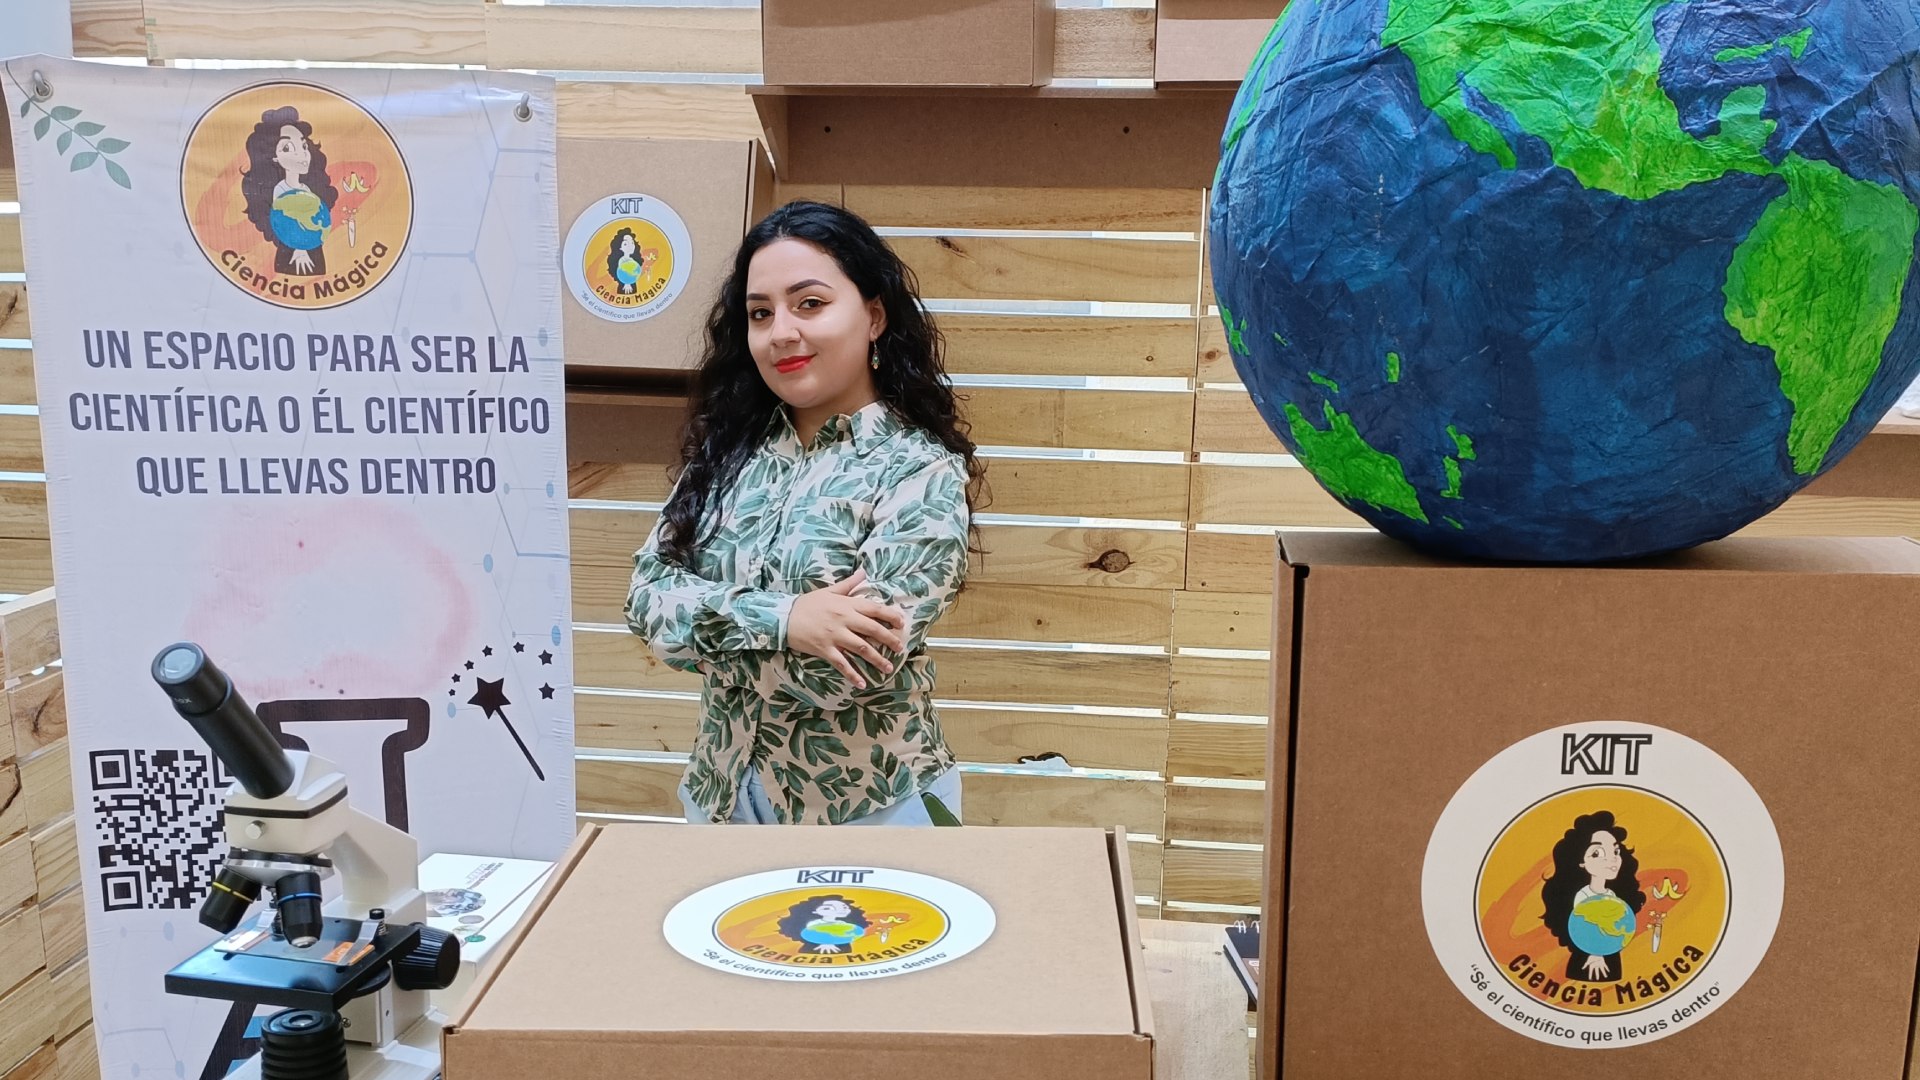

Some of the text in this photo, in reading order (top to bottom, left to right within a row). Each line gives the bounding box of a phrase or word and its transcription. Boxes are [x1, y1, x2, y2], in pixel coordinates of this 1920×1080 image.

[611, 197, 643, 214] KIT
[221, 241, 388, 300] Ciencia Mágica
[595, 285, 631, 305] Ciencia
[636, 308, 655, 318] llevas
[83, 329, 530, 374] UN ESPACIO PARA SER LA
[69, 387, 550, 434] CIENTÍFICA O ÉL CIENTÍFICO
[136, 456, 496, 498] QUE LLEVAS DENTRO
[1561, 732, 1652, 776] KIT
[796, 869, 874, 884] KIT
[719, 958, 735, 966] el
[811, 970, 843, 980] que
[849, 965, 898, 978] llevas
[742, 937, 929, 964] Ciencia Mágica
[1508, 943, 1705, 1007] Ciencia Mágica
[1486, 989, 1504, 1006] el
[1502, 1001, 1575, 1040] científico
[1580, 1029, 1613, 1045] que
[1618, 1018, 1668, 1041] llevas
